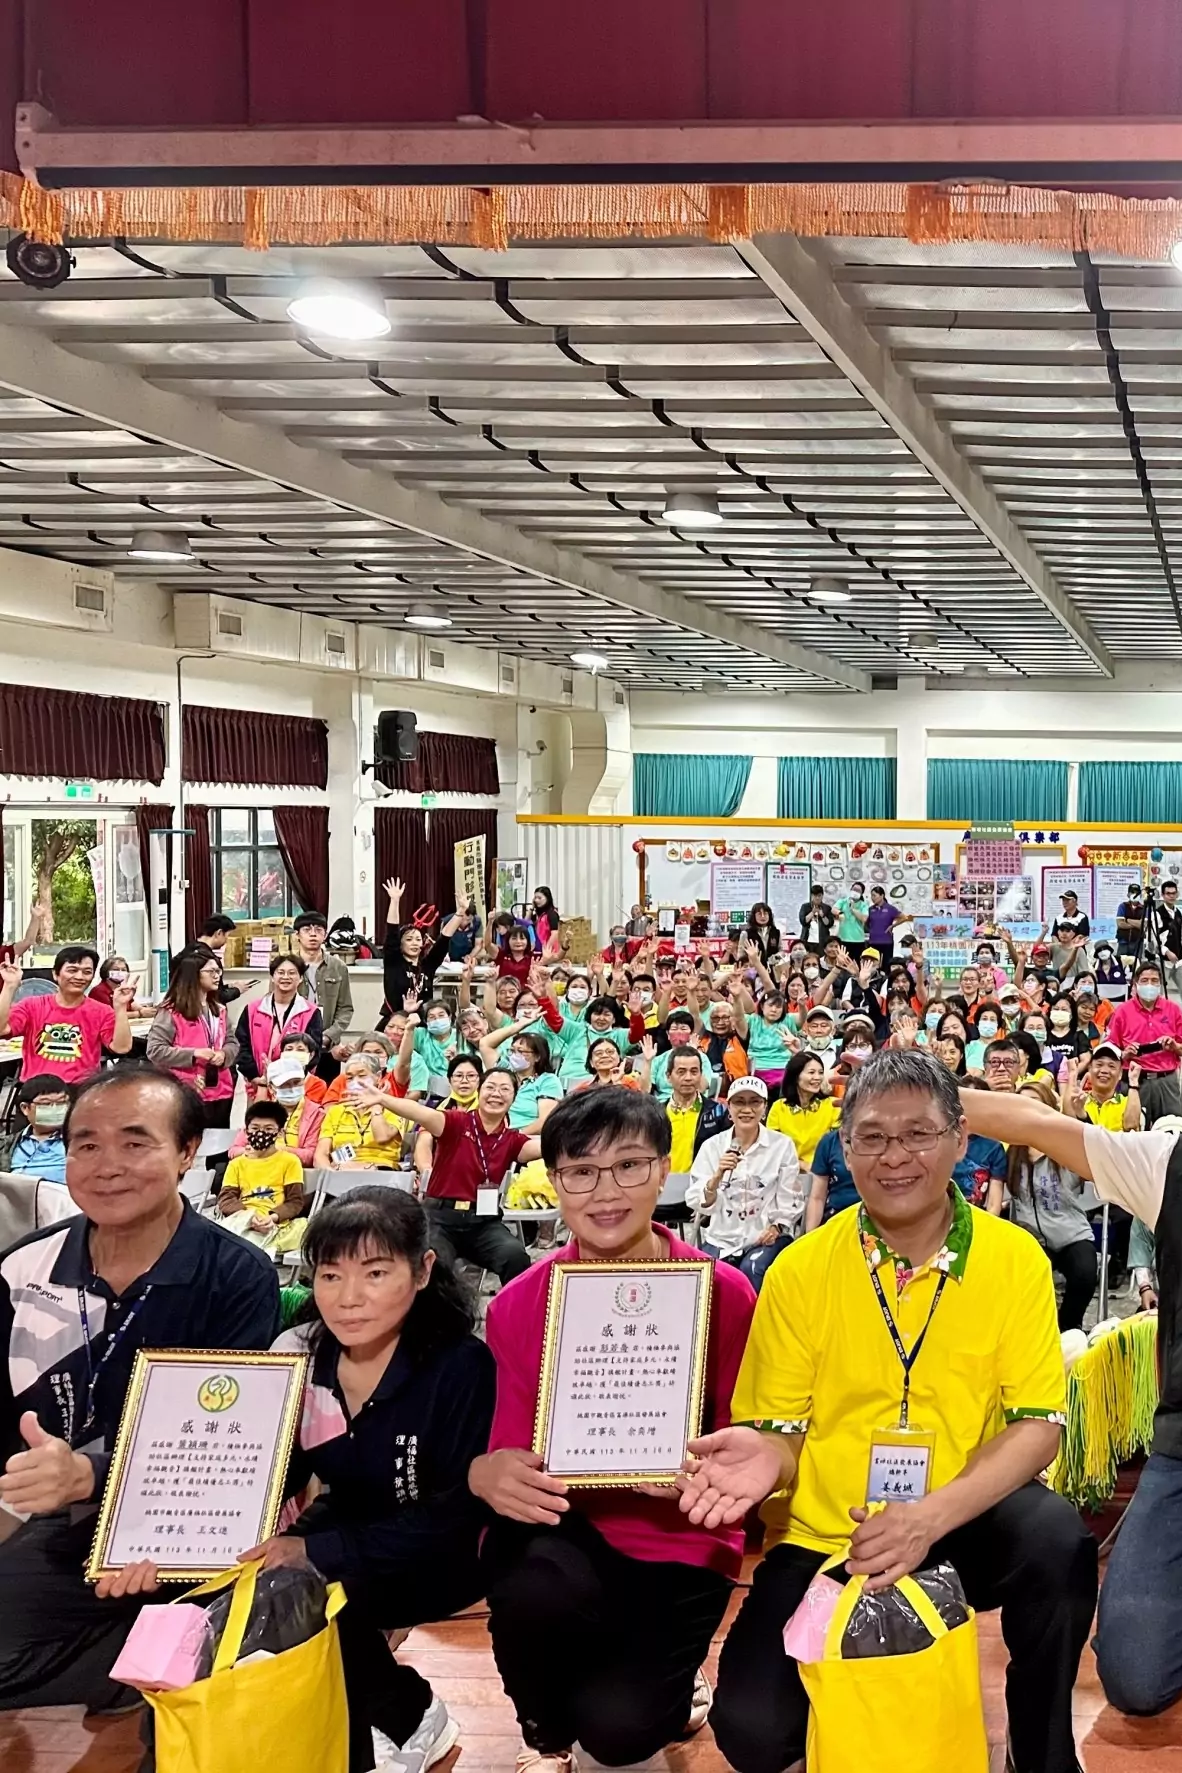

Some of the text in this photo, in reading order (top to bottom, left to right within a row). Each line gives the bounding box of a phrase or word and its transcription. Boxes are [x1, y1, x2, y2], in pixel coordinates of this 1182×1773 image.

[1019, 831, 1060, 844] 俱樂部
[600, 1323, 660, 1337] 感謝狀
[180, 1420, 243, 1434] 感謝狀
[586, 1427, 617, 1437] 理事長
[153, 1525, 185, 1535] 理事長
